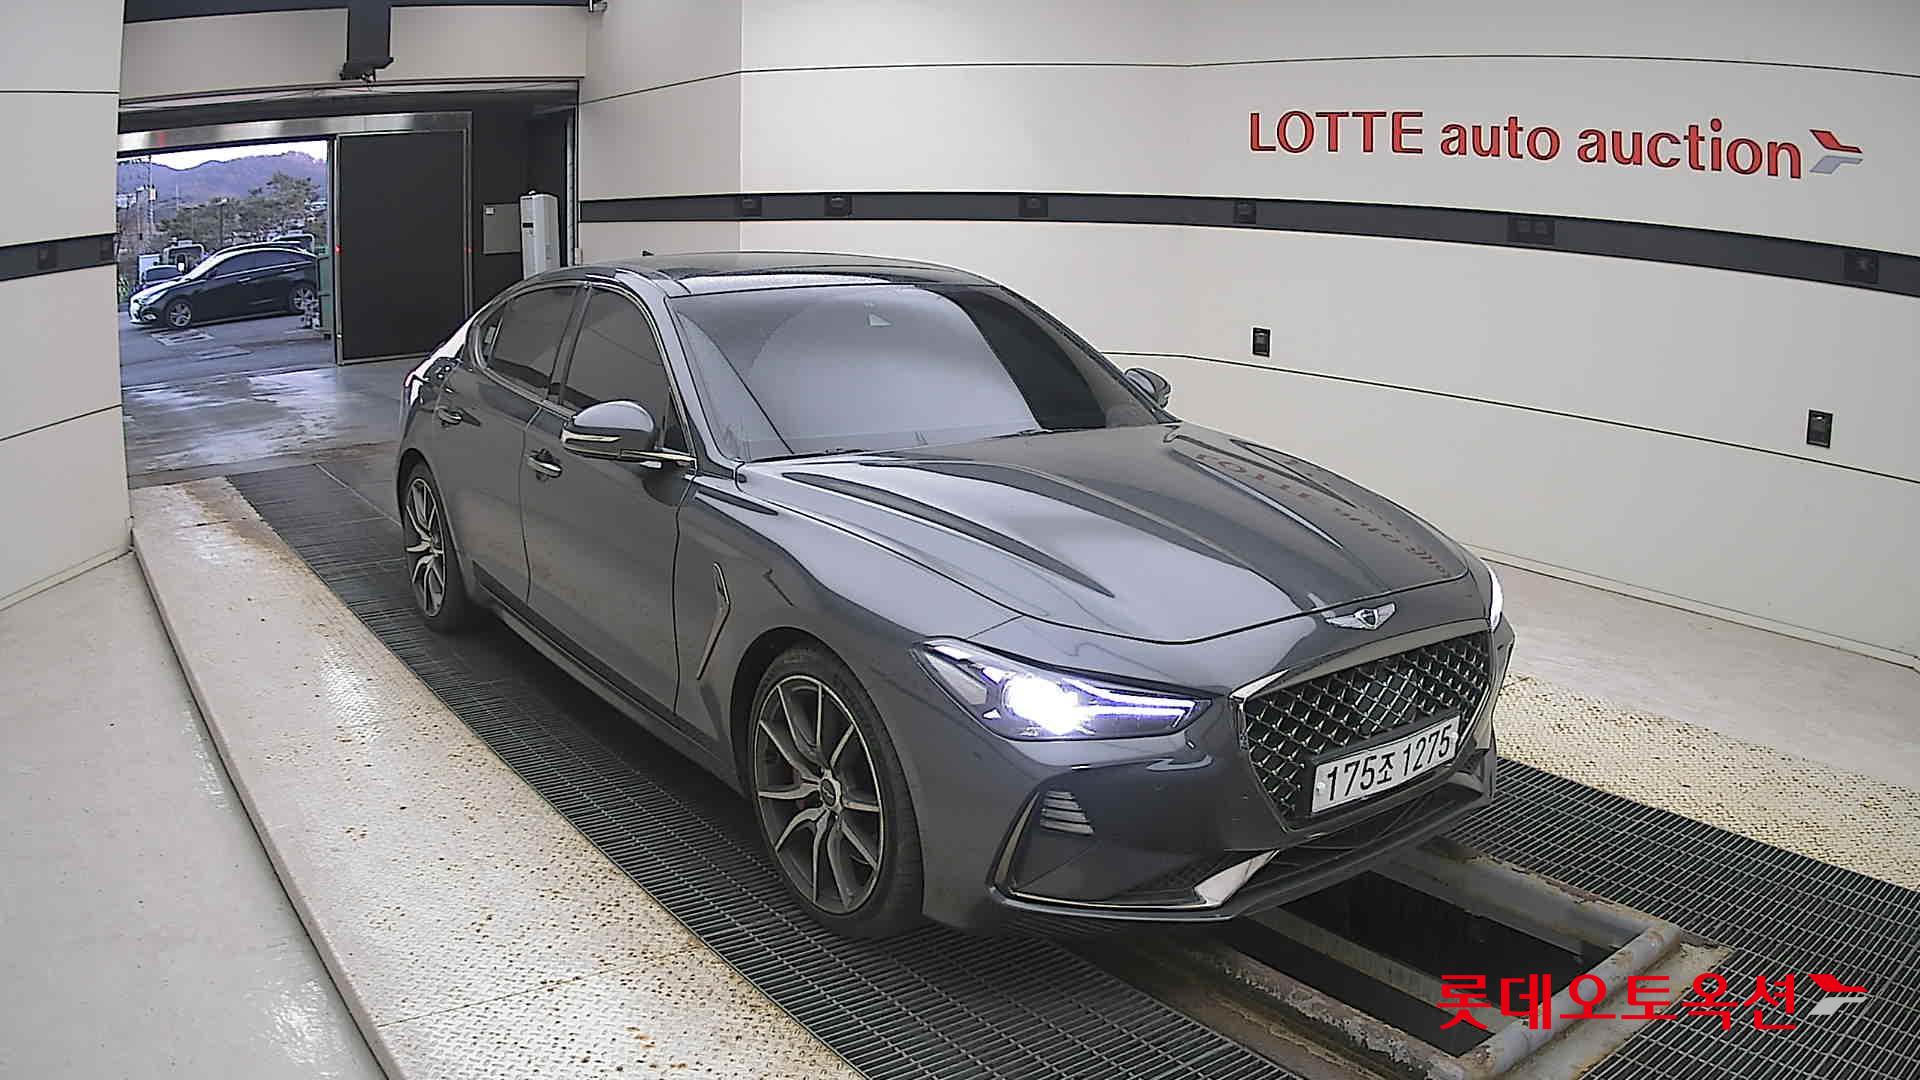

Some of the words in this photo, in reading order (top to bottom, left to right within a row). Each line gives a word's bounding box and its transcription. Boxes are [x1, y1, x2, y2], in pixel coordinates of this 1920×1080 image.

[1249, 111, 1424, 154] LOTTE
[1440, 116, 1561, 160] auto
[1577, 118, 1802, 179] auction
